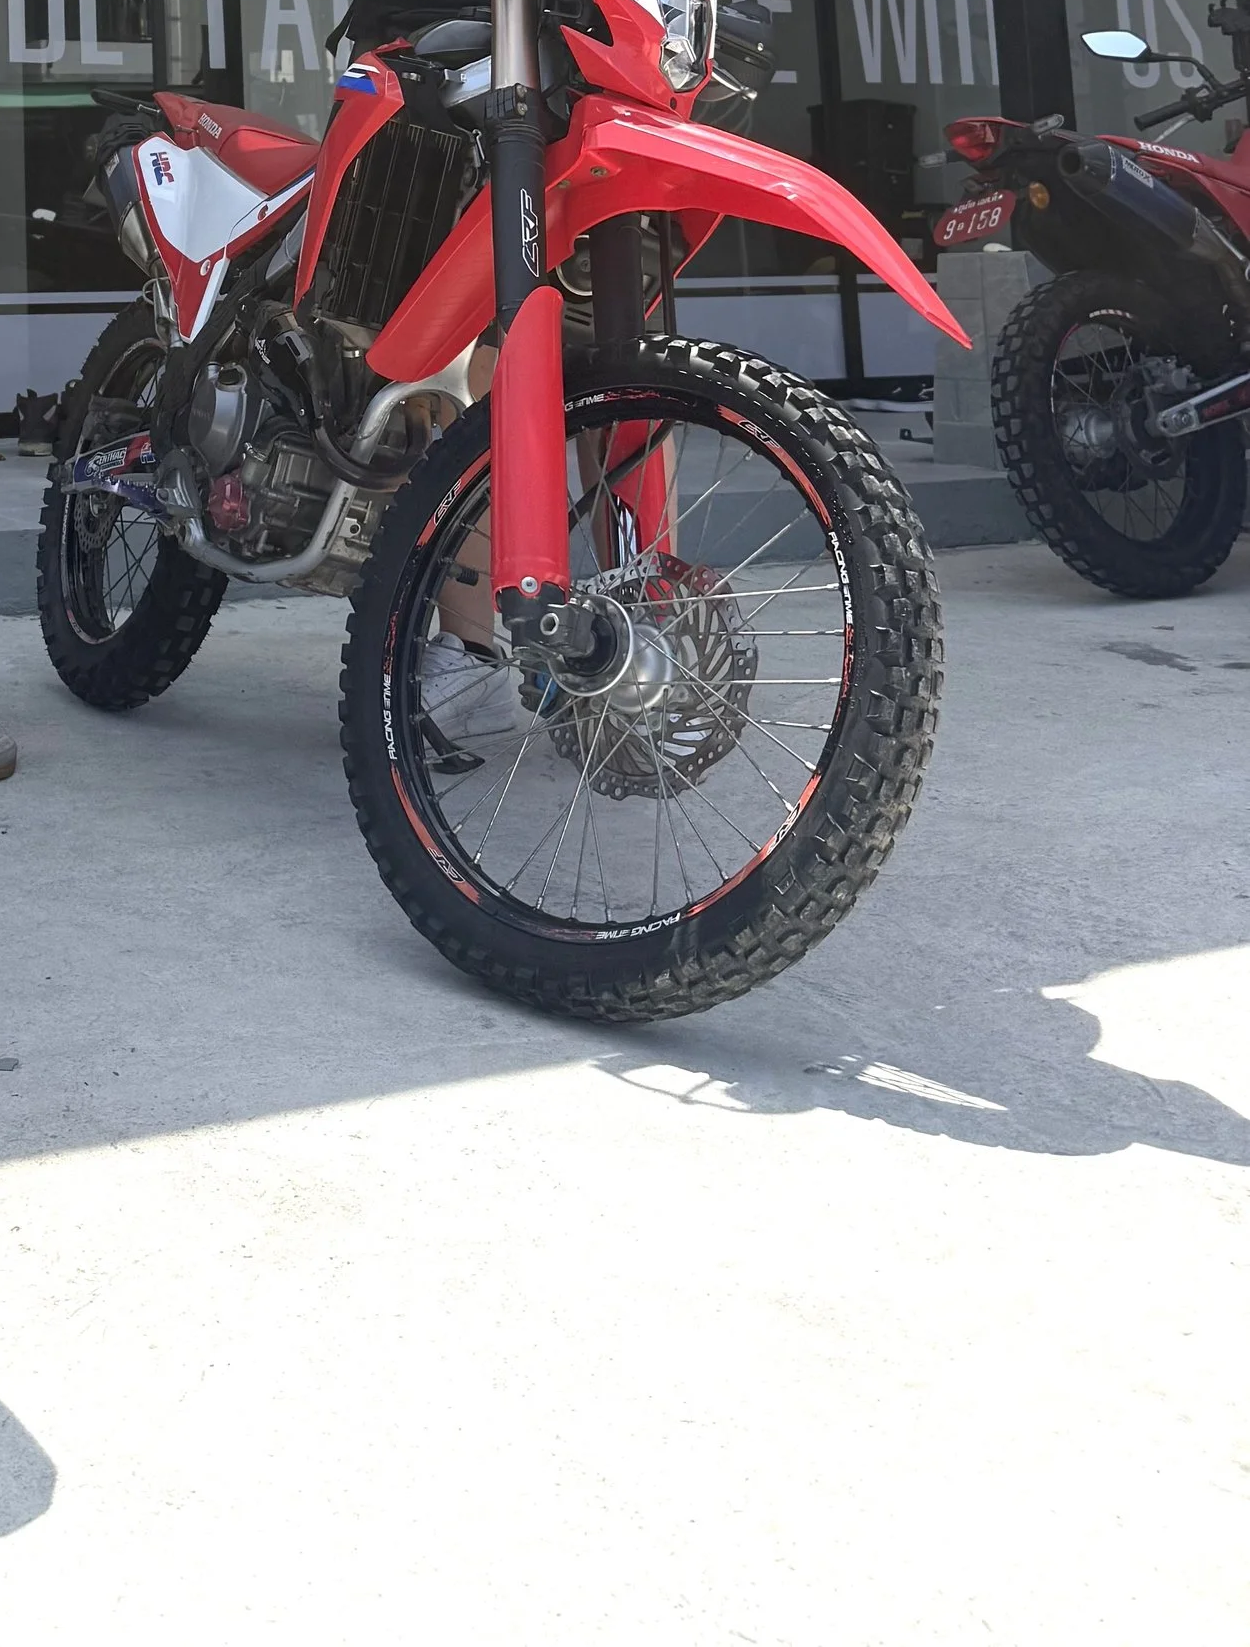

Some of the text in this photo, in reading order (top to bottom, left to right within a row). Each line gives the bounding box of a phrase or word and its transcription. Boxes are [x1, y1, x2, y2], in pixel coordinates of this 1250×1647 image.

[197, 112, 223, 139] HONDA
[1136, 141, 1200, 164] HONDA
[149, 151, 175, 186] HRC
[829, 531, 850, 584] RACING
[382, 709, 398, 760] RACING
[631, 912, 681, 937] RACING
